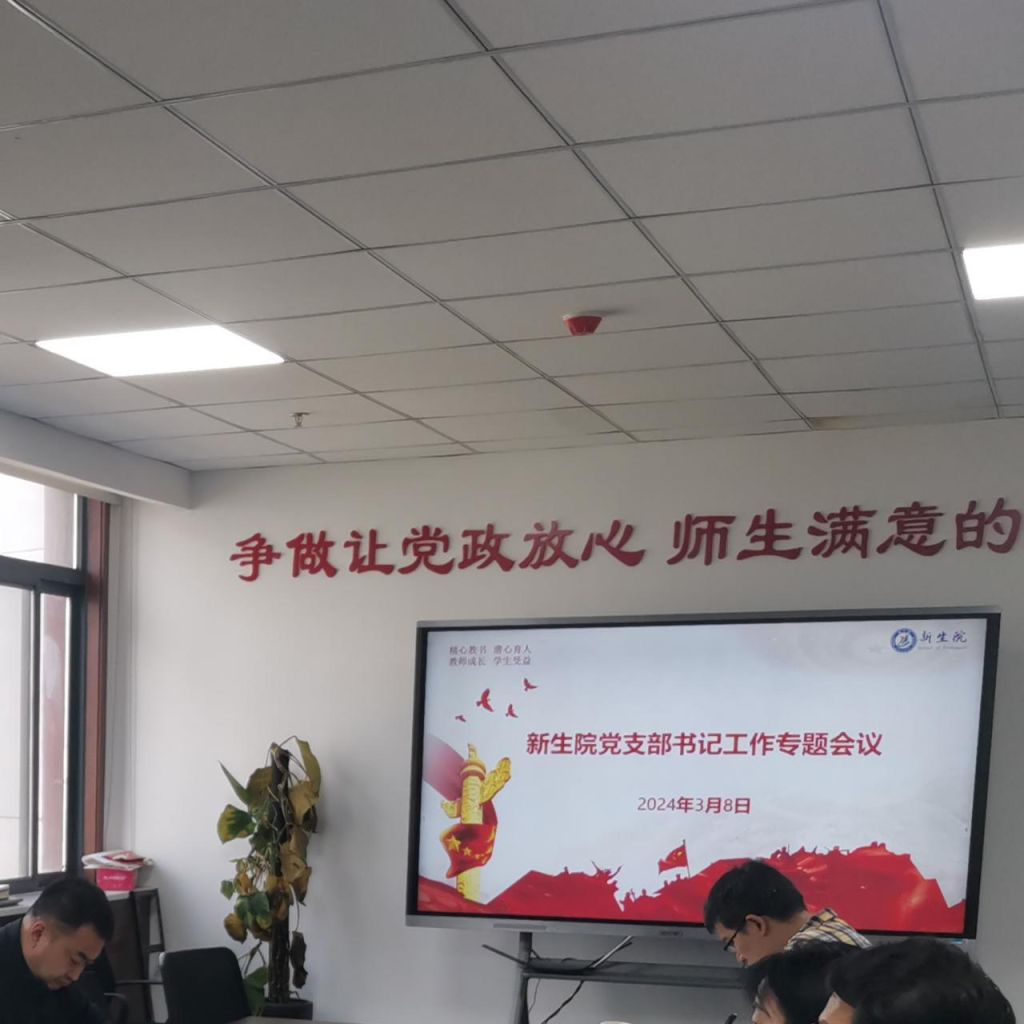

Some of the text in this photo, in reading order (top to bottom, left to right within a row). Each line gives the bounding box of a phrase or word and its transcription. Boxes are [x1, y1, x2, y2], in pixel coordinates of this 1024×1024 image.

[229, 495, 1022, 583] 争做让党政放心 师生满意的
[527, 730, 883, 758] 新生院党支部书记工作专题会议
[637, 796, 752, 815] 2024年3月8日
